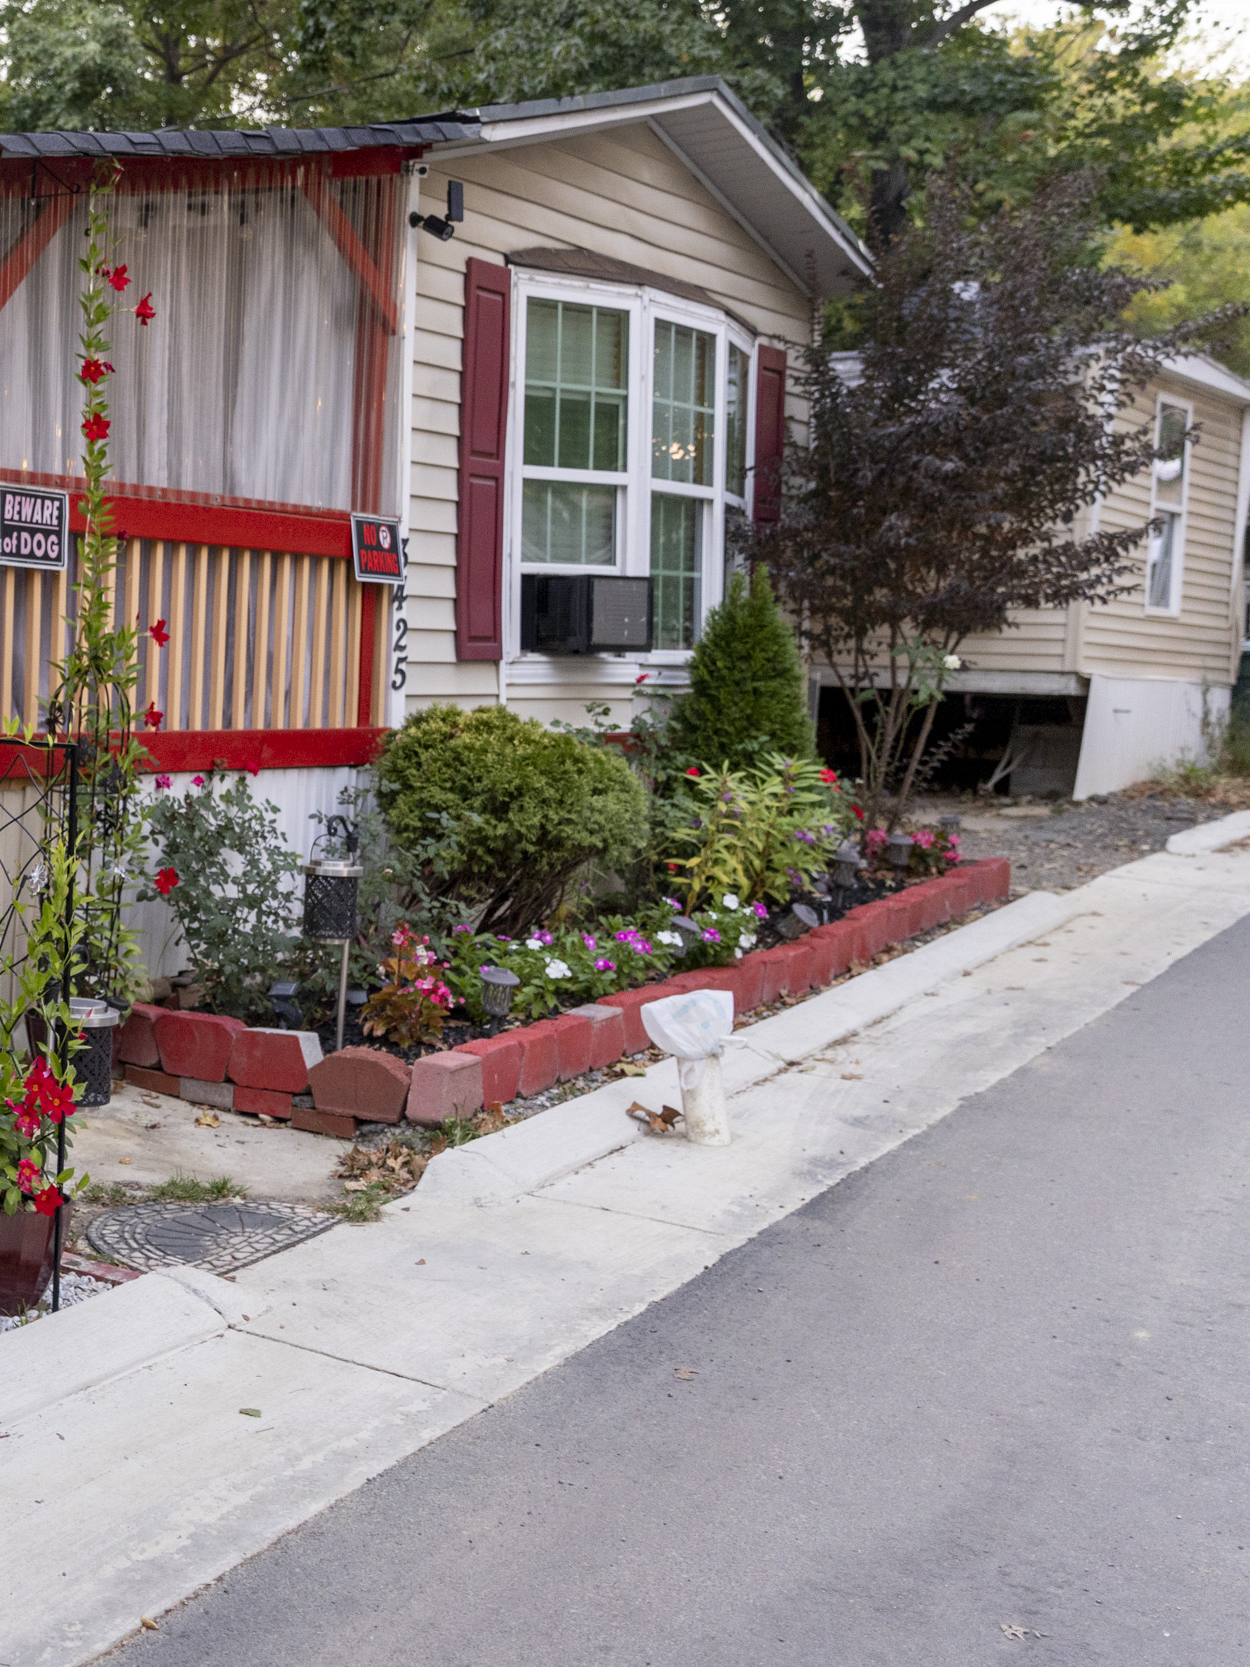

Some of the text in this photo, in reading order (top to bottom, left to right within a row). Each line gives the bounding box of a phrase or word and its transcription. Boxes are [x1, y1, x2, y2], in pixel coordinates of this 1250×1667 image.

[4, 494, 60, 526] BEWARE
[3, 531, 59, 559] of DOG
[363, 523, 377, 546] NO
[360, 549, 399, 574] PARKING
